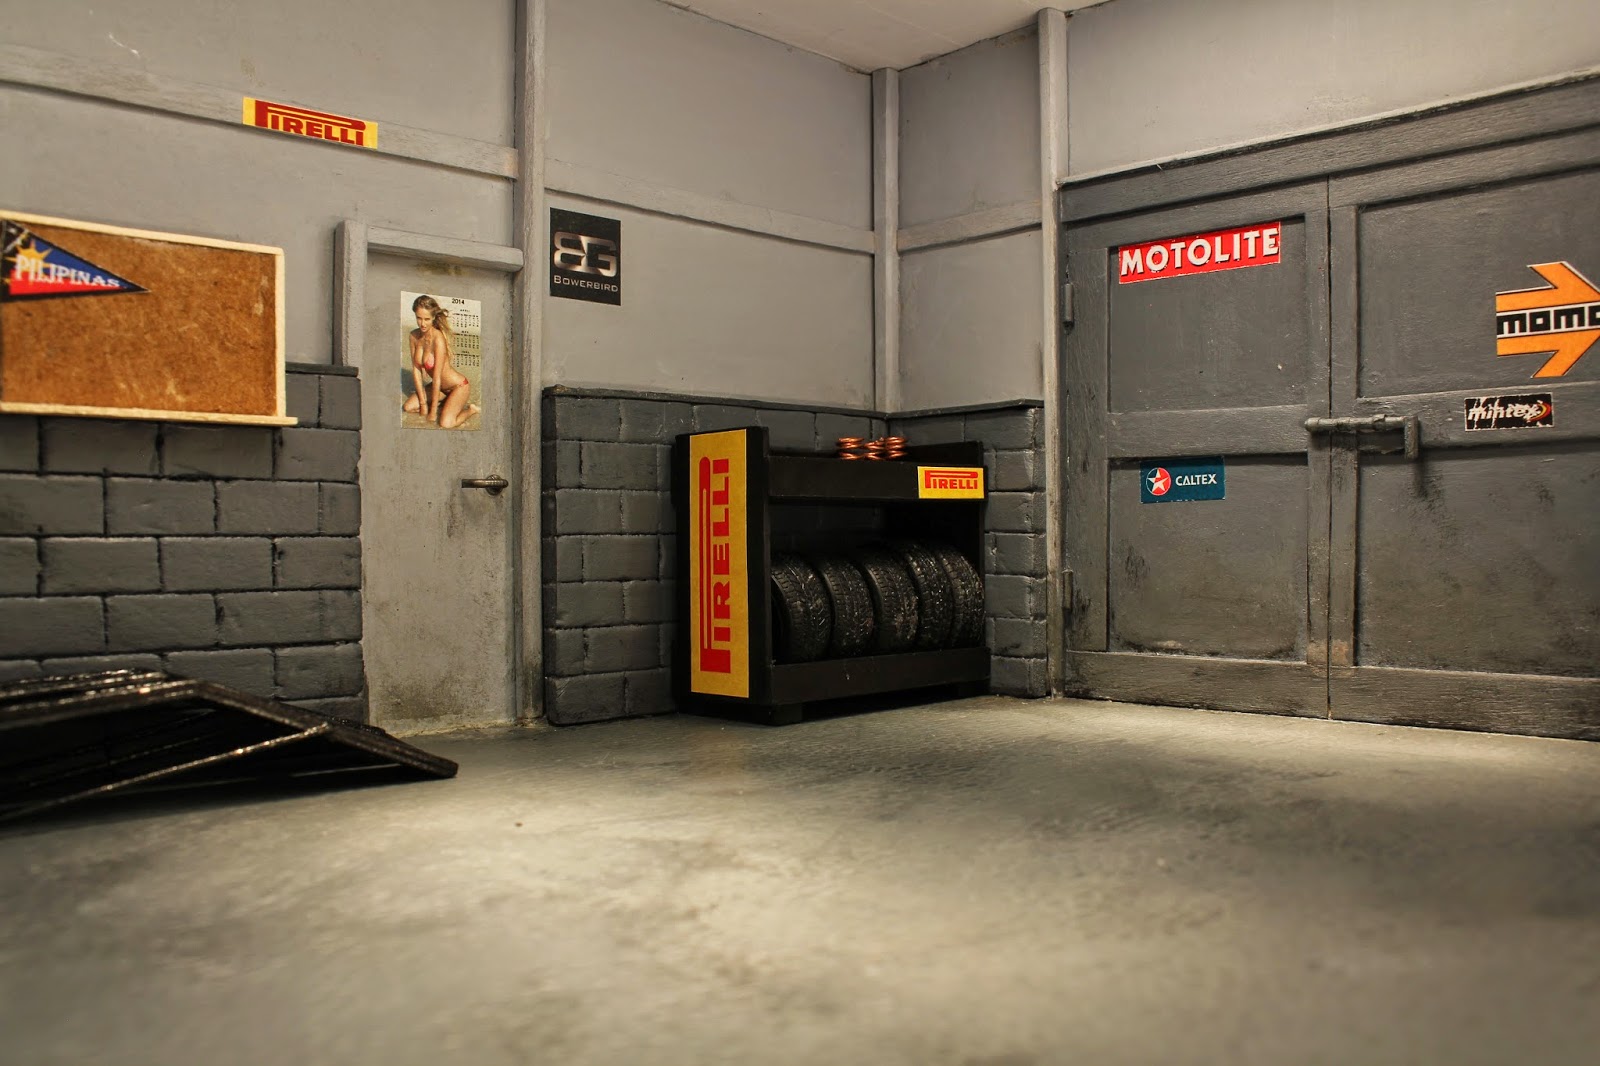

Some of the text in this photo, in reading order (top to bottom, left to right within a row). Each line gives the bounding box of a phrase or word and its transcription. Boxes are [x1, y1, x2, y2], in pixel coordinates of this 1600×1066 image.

[255, 100, 366, 146] PIRELLI
[14, 254, 120, 287] PILIPINAS
[1120, 228, 1279, 275] MOTOLITE
[924, 470, 978, 489] PIRELLI
[1175, 474, 1217, 486] CALTEX
[699, 456, 731, 674] PIRELLI
